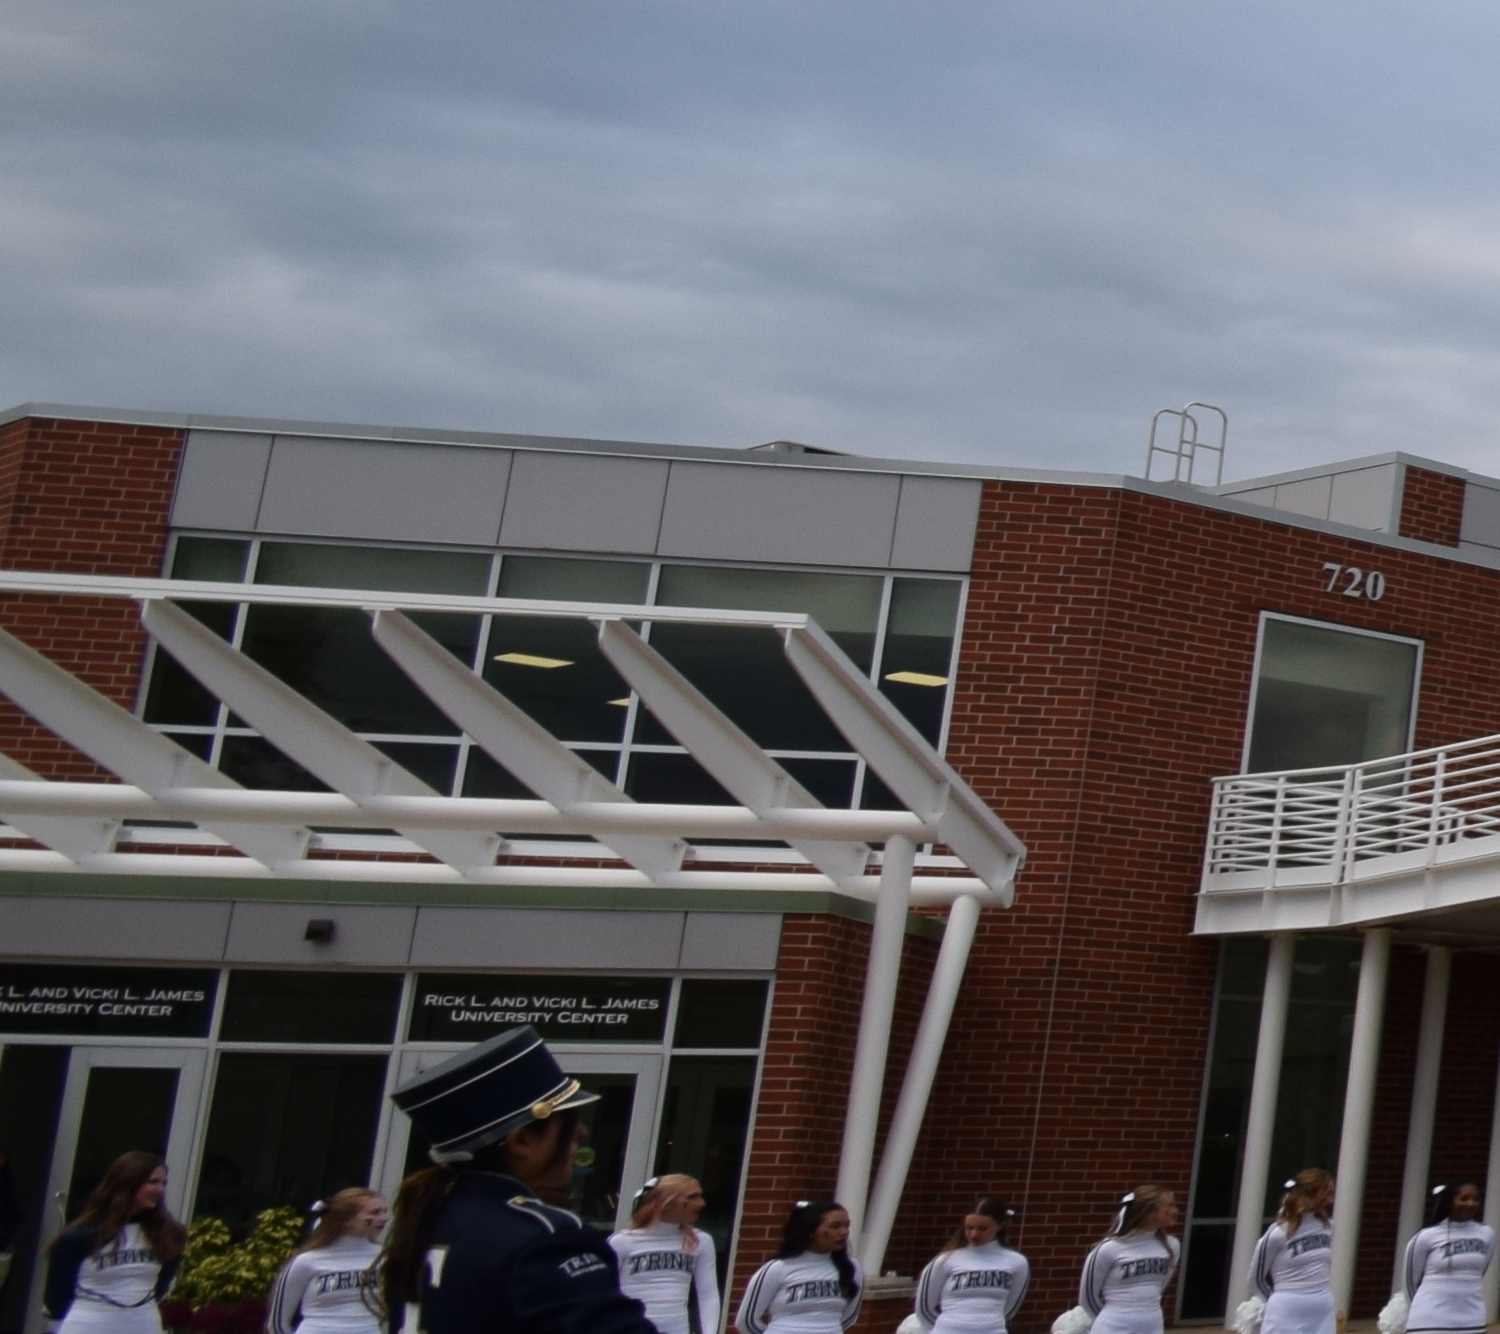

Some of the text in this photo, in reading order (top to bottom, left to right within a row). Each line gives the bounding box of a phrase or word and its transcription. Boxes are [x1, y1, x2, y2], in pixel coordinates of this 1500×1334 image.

[1322, 562, 1385, 601] 720
[0, 1001, 94, 1014] NIVERSITY
[785, 1280, 840, 1304] TRIN
